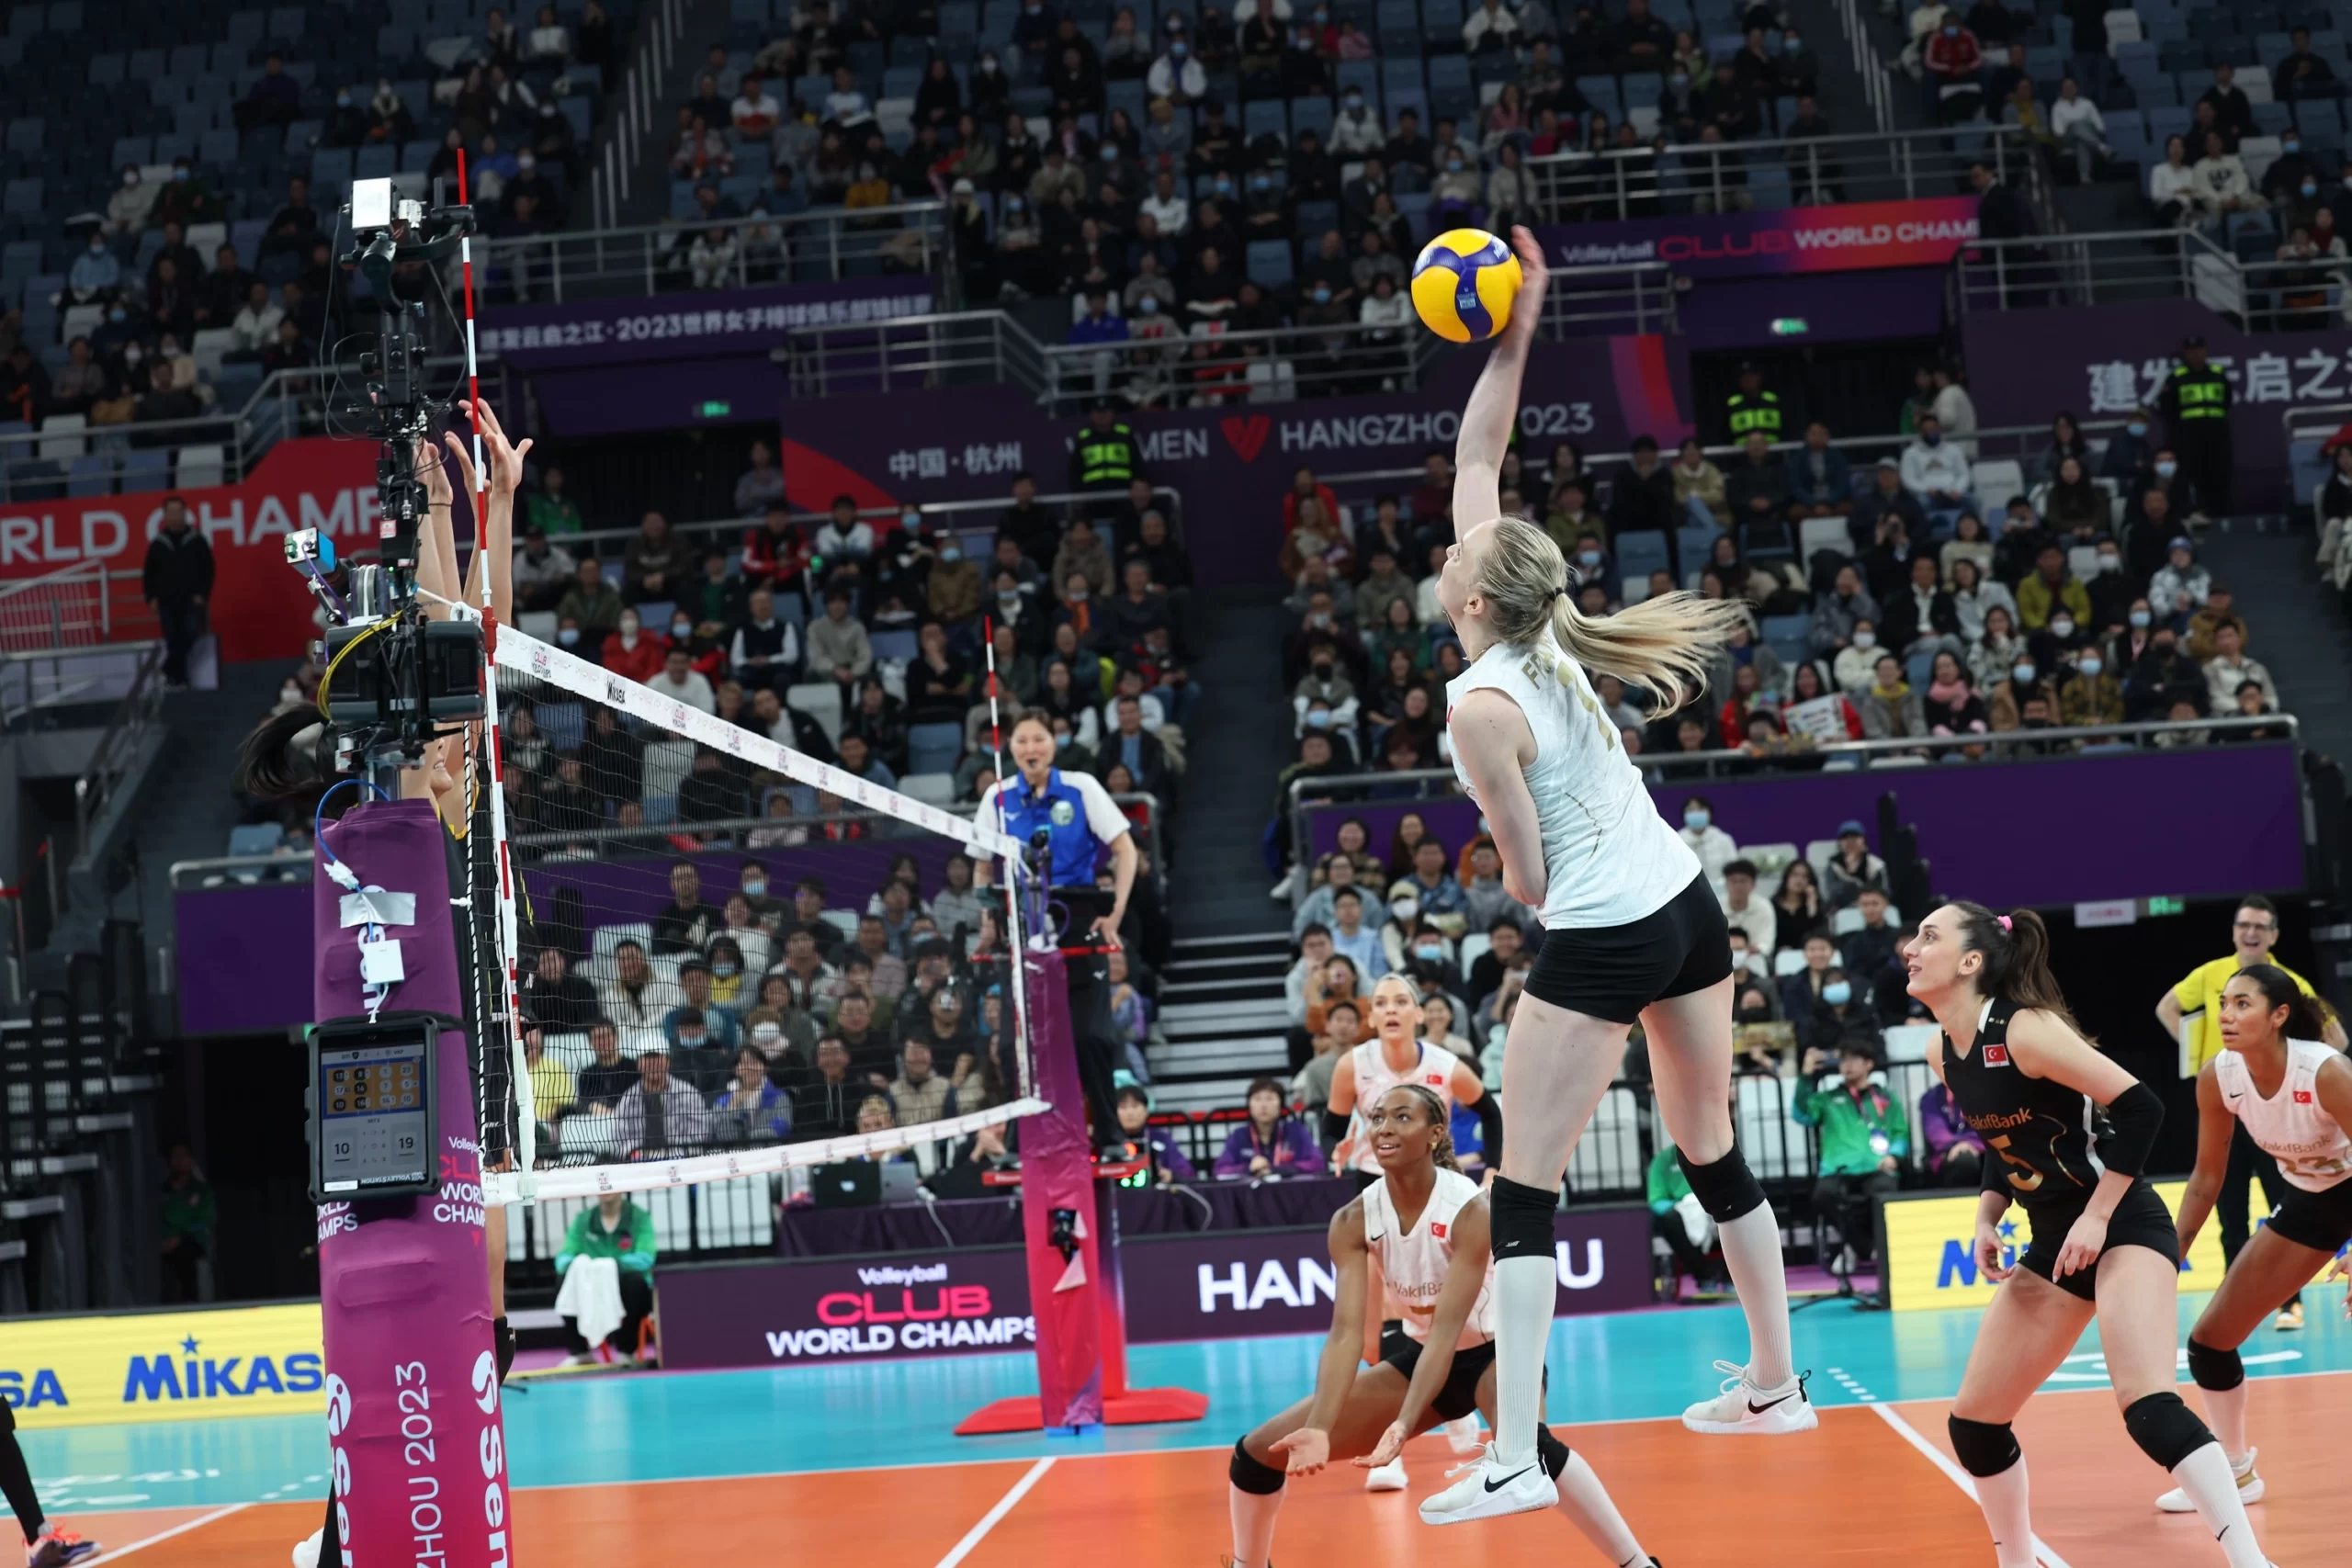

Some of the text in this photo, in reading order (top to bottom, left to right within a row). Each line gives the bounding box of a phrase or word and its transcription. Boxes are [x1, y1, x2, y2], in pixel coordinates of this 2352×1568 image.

[1564, 242, 1654, 265] Volleyball
[1658, 231, 1791, 260] CLUB
[1794, 228, 1891, 250] WORLD
[1281, 411, 1459, 451] HANGZHO
[1520, 402, 1594, 437] 023
[334, 1136, 414, 1156] 10 19
[1987, 1134, 2043, 1191] 5
[858, 1263, 947, 1286] Volleyball
[817, 1286, 992, 1325] CLUB
[766, 1323, 896, 1358] WORLD
[395, 1361, 436, 1465] 2023
